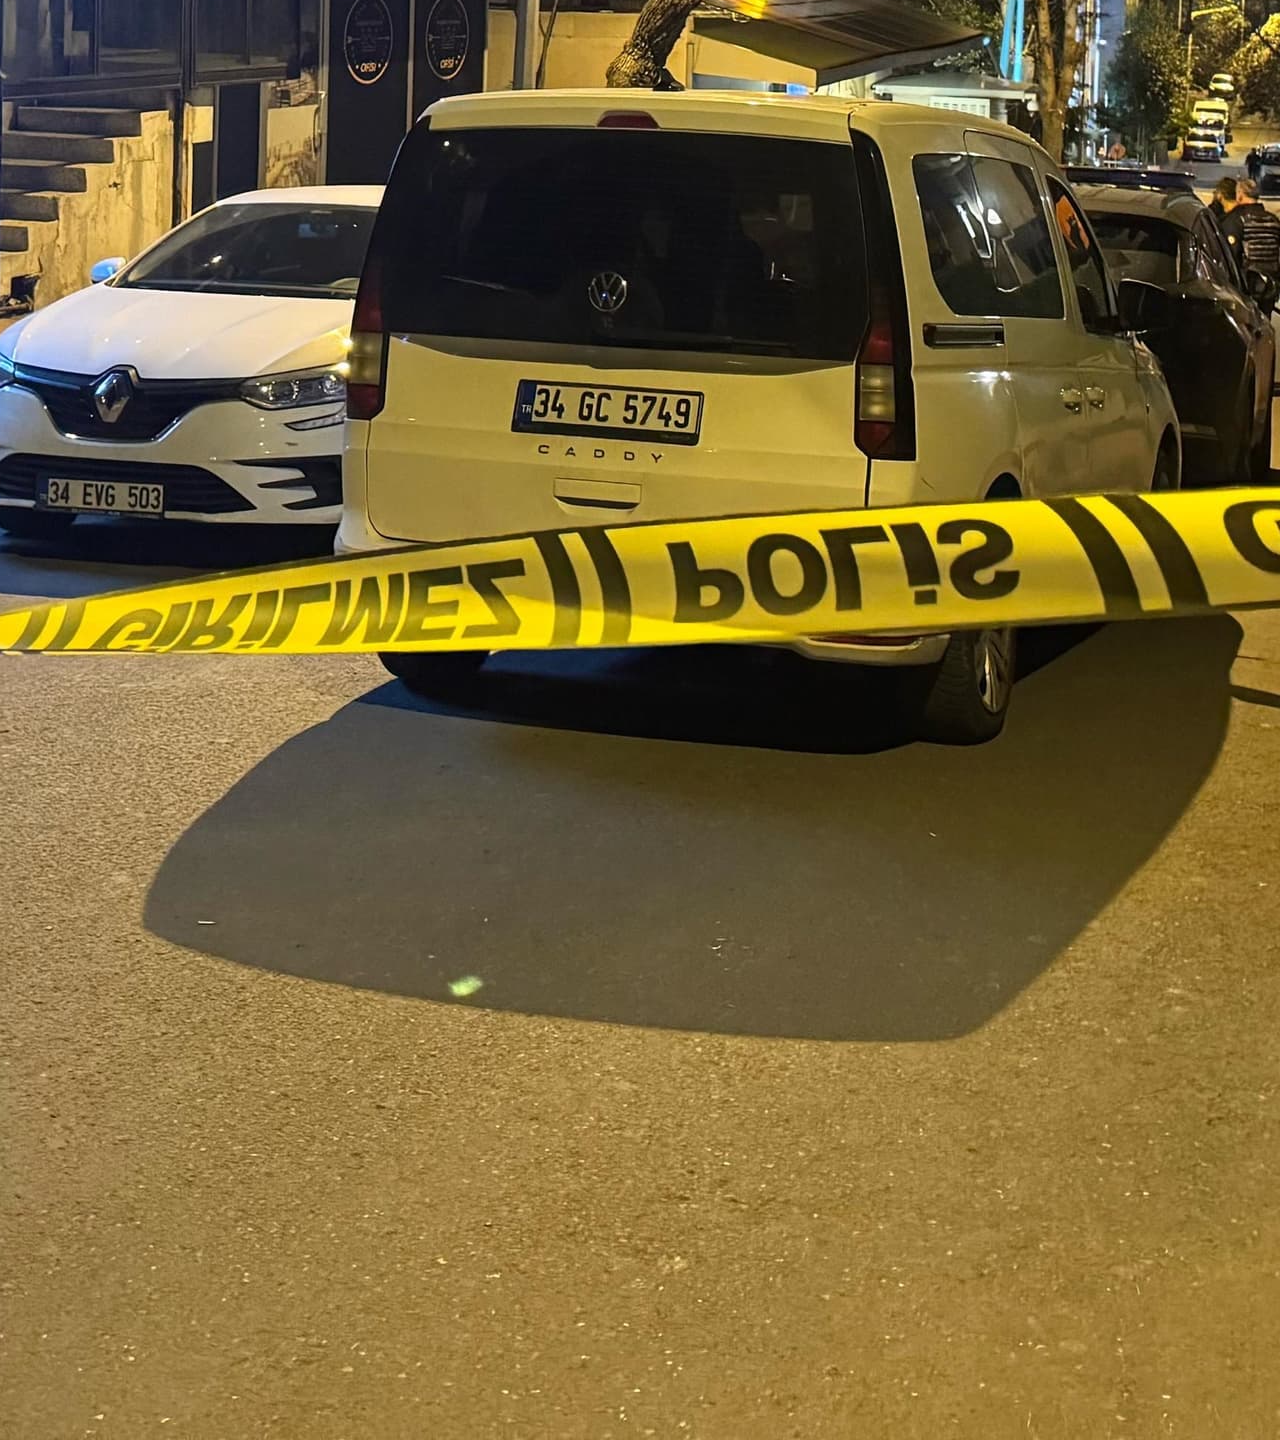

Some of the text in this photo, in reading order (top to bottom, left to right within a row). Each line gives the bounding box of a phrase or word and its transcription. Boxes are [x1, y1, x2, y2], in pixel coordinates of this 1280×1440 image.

[534, 387, 565, 419] 34
[578, 390, 612, 422] GC
[622, 393, 691, 428] 5749
[537, 443, 663, 463] CADDY
[49, 481, 70, 504] 34
[82, 483, 116, 507] EVG
[127, 485, 162, 510] 503
